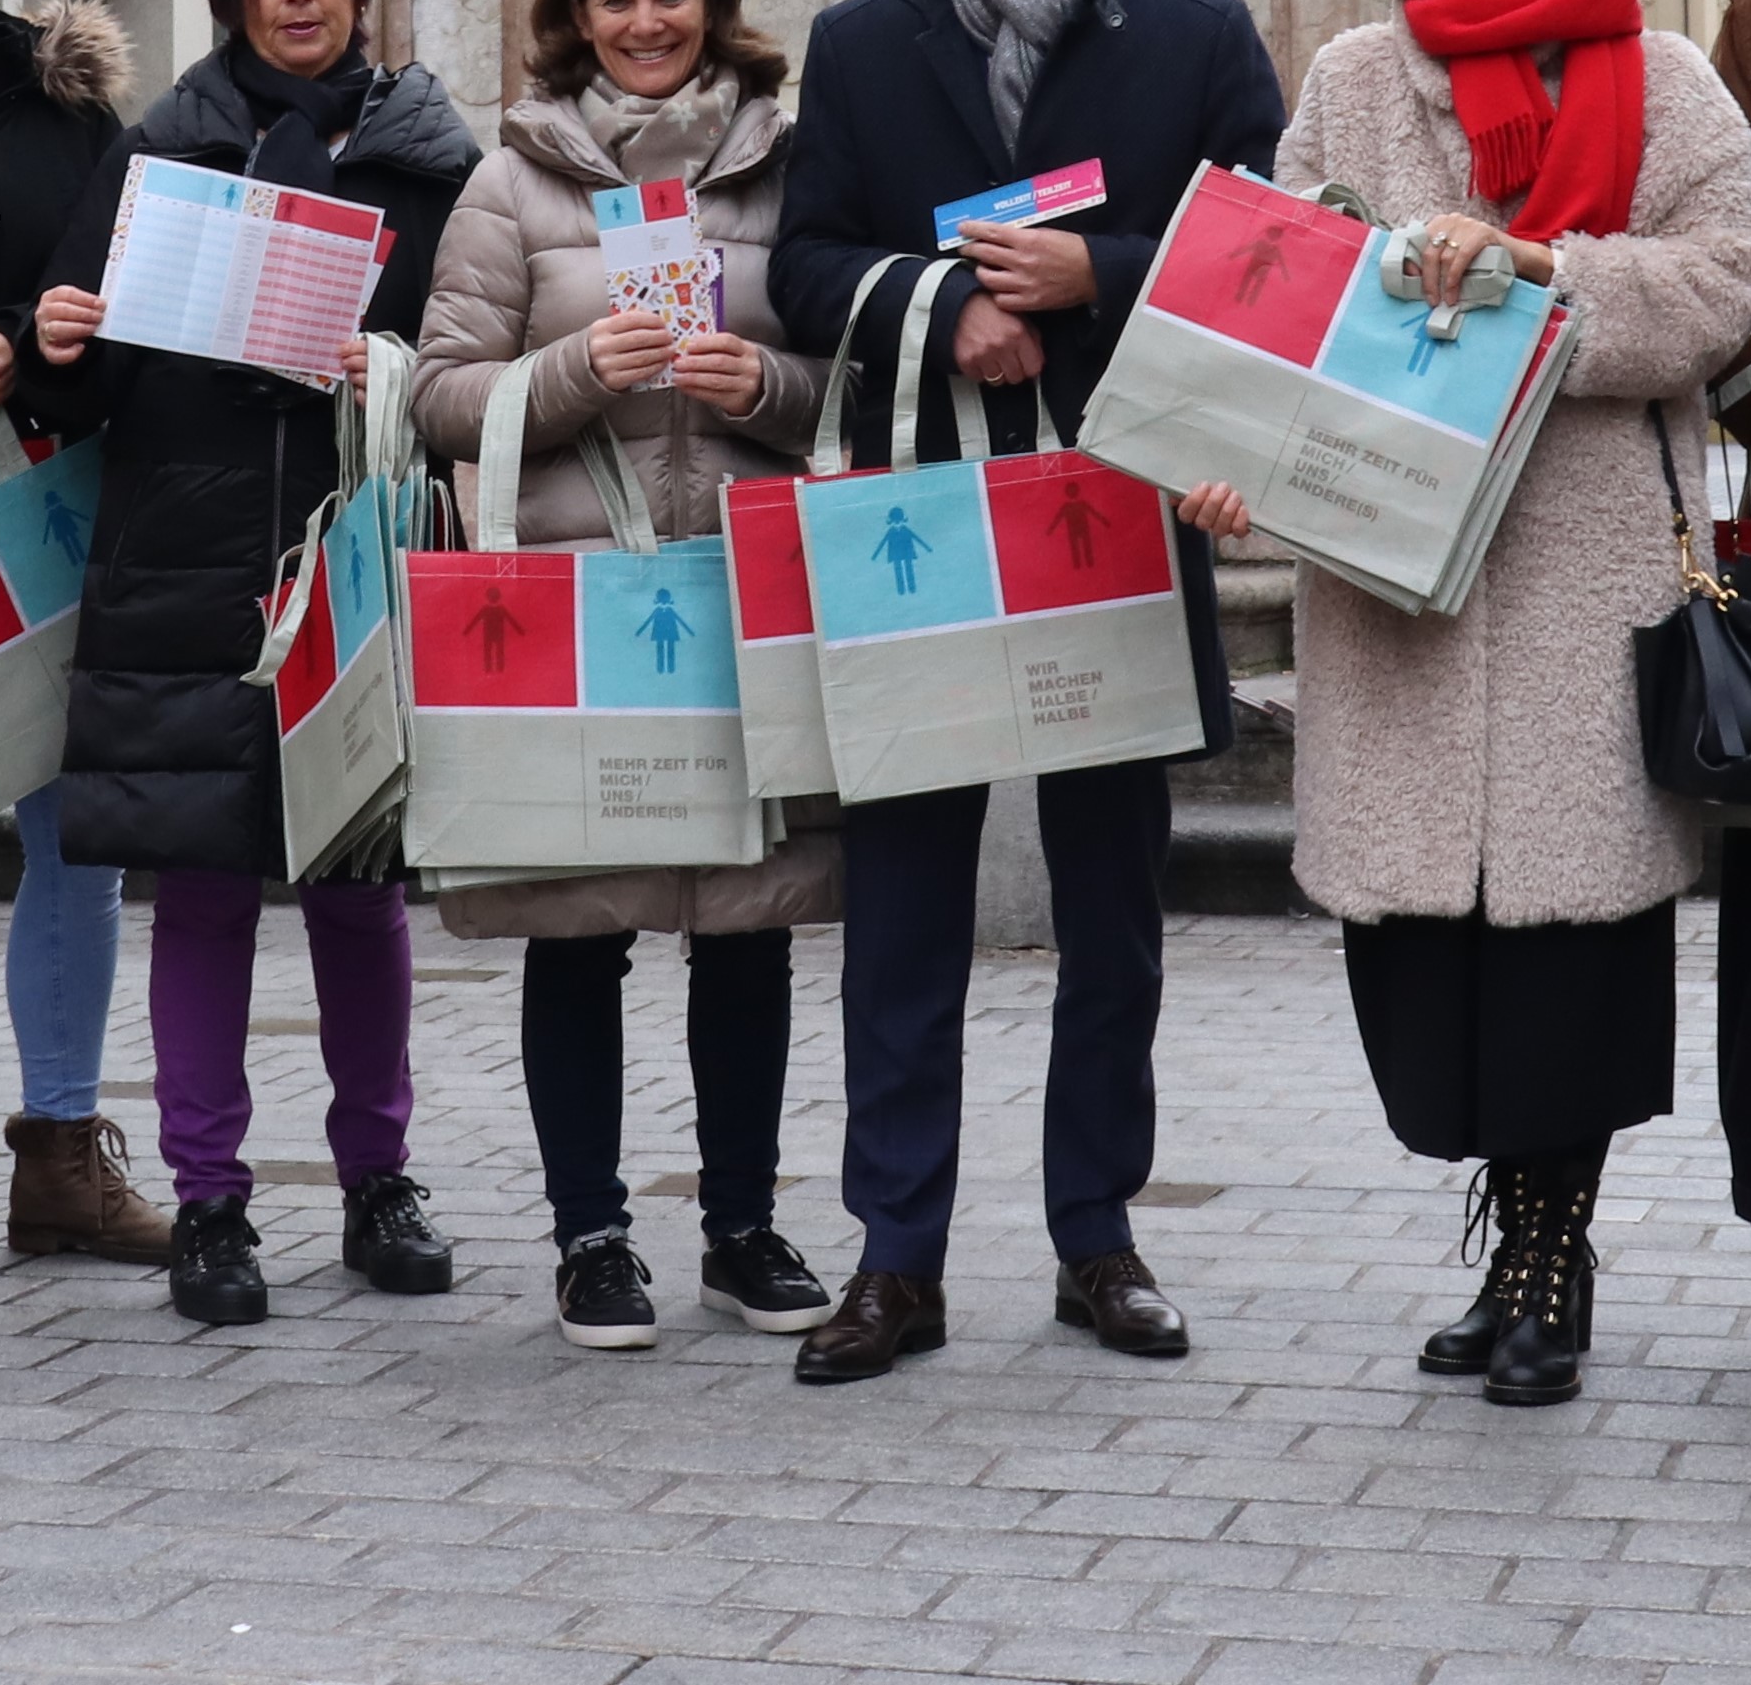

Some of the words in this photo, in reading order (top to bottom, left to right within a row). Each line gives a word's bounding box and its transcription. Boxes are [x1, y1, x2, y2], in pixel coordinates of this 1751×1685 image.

[1306, 427, 1359, 457] MEHR
[1360, 448, 1402, 474] ZEIT
[1403, 466, 1440, 491] FÜR
[1287, 475, 1379, 522] ANDERE(S)
[1025, 661, 1058, 676] WIR
[1029, 671, 1103, 693] MACHEN
[1031, 689, 1088, 709] HALBE
[1033, 706, 1091, 726] HALBE
[599, 757, 648, 771] MEHR
[652, 758, 689, 771] ZEIT
[694, 754, 728, 771] FÜR
[600, 804, 688, 820] ANDERE(S)
